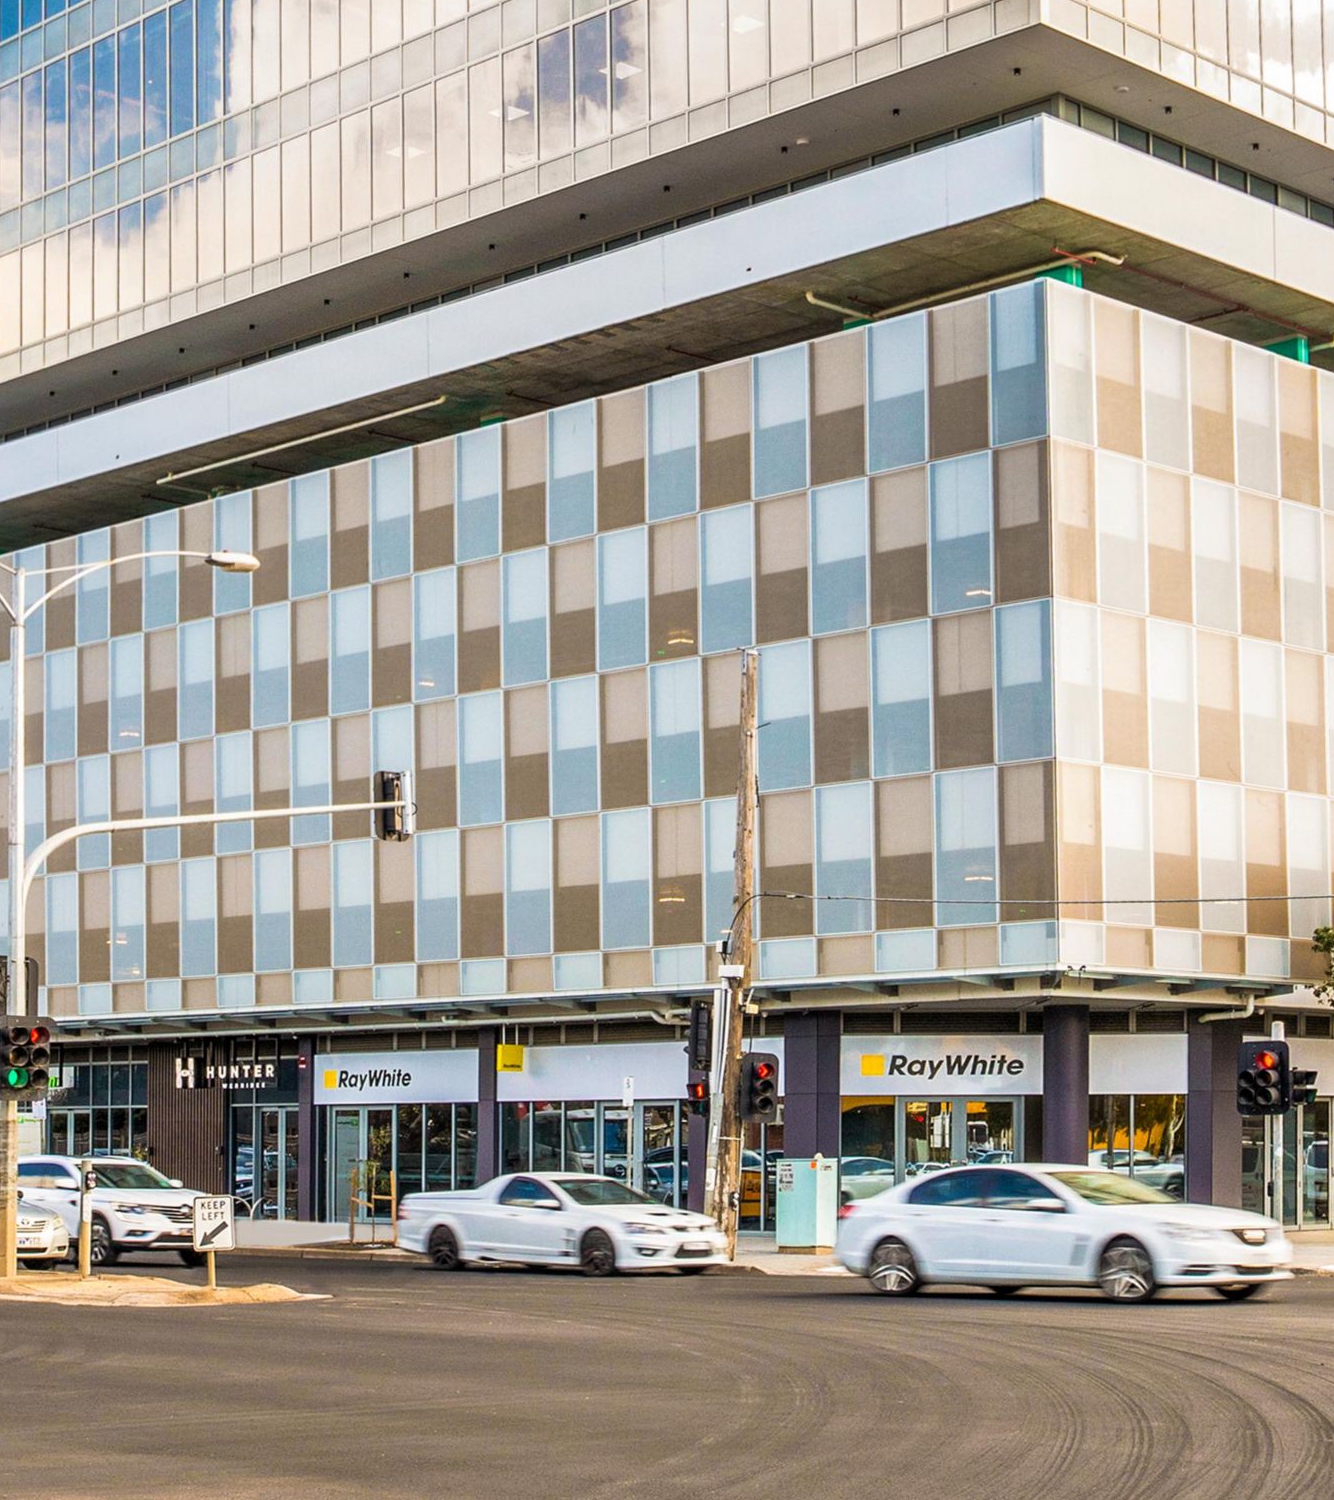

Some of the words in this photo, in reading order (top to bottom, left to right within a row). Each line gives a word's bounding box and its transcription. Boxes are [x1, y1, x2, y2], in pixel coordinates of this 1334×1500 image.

[206, 1064, 275, 1079] HUNTER
[888, 1054, 1025, 1080] RayWhite
[338, 1068, 412, 1091] RayWhite
[200, 1201, 226, 1210] KEEP
[201, 1212, 225, 1221] LEFT
